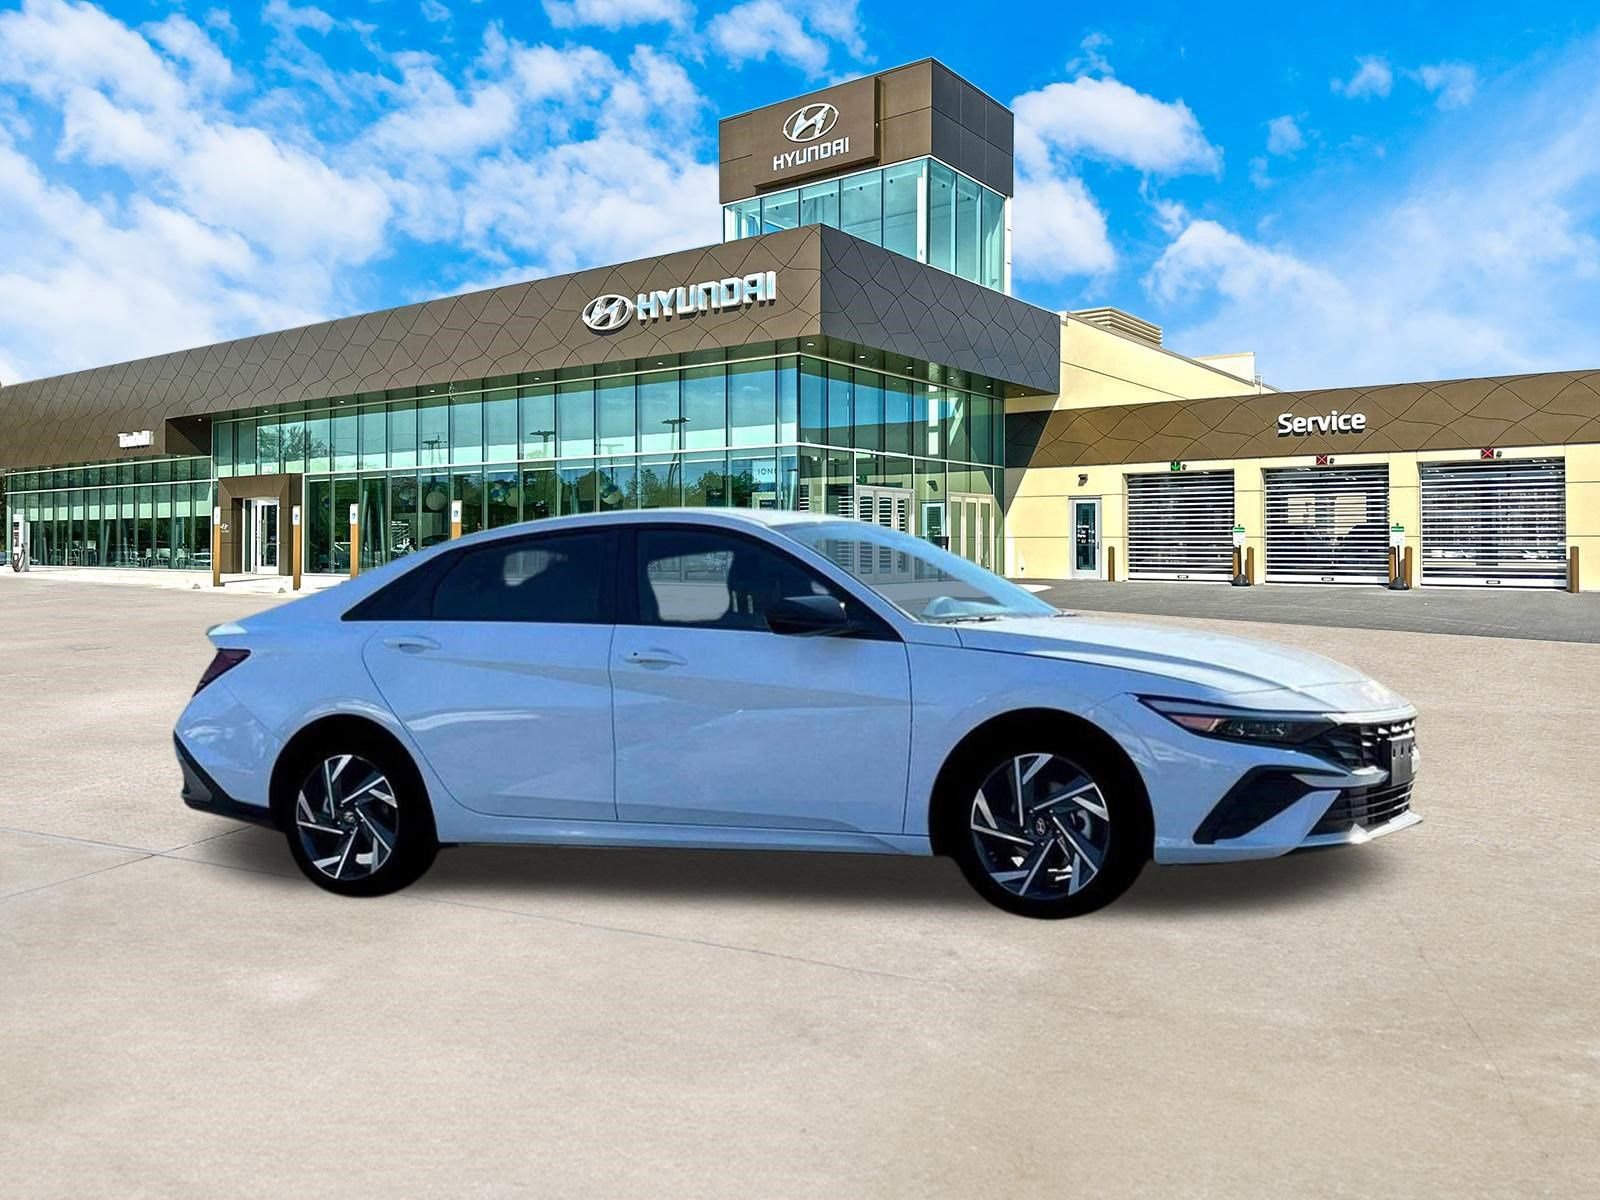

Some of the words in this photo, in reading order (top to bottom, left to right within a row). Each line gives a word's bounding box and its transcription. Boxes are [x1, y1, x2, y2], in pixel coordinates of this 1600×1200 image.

[773, 137, 849, 171] HYUNDAI
[636, 271, 777, 321] HYUNDAI
[1277, 410, 1367, 434] Service
